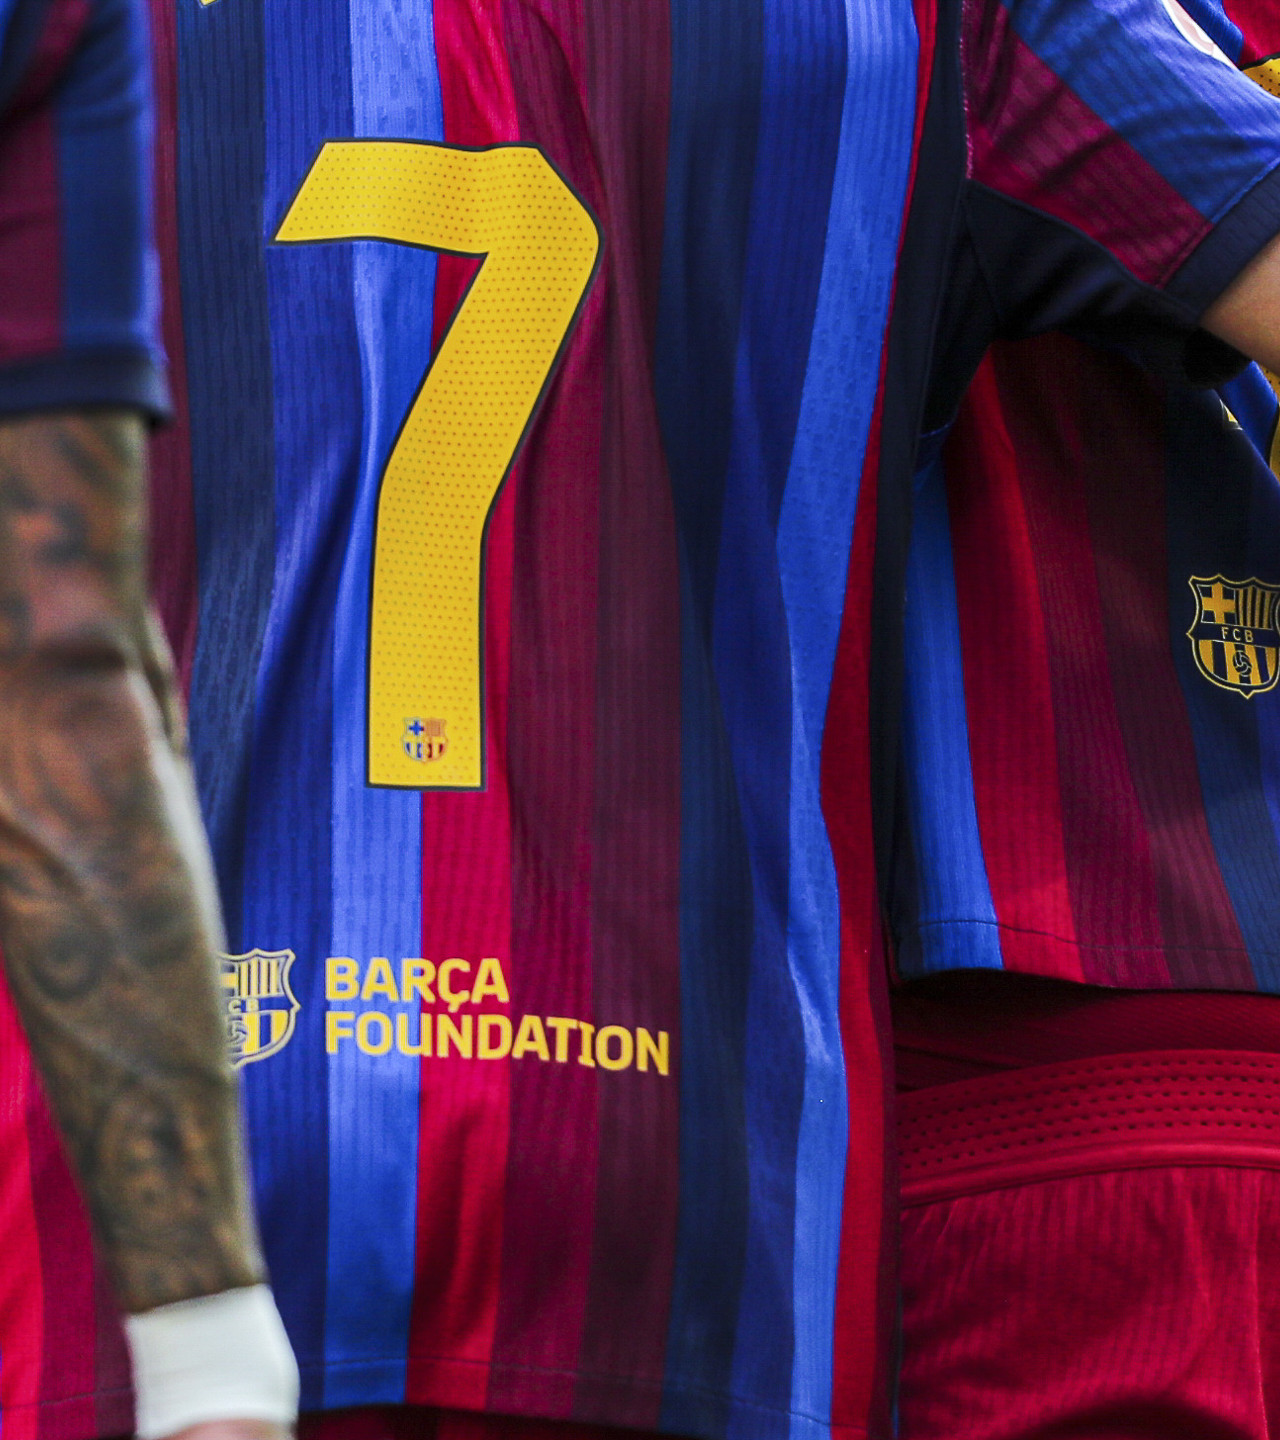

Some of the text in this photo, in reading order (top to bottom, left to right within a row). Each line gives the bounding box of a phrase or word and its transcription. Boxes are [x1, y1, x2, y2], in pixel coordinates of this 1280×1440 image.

[267, 137, 604, 791] 7
[1220, 625, 1254, 643] FCB
[324, 957, 510, 1013] BARÇA
[324, 1010, 670, 1076] FOUNDATION
